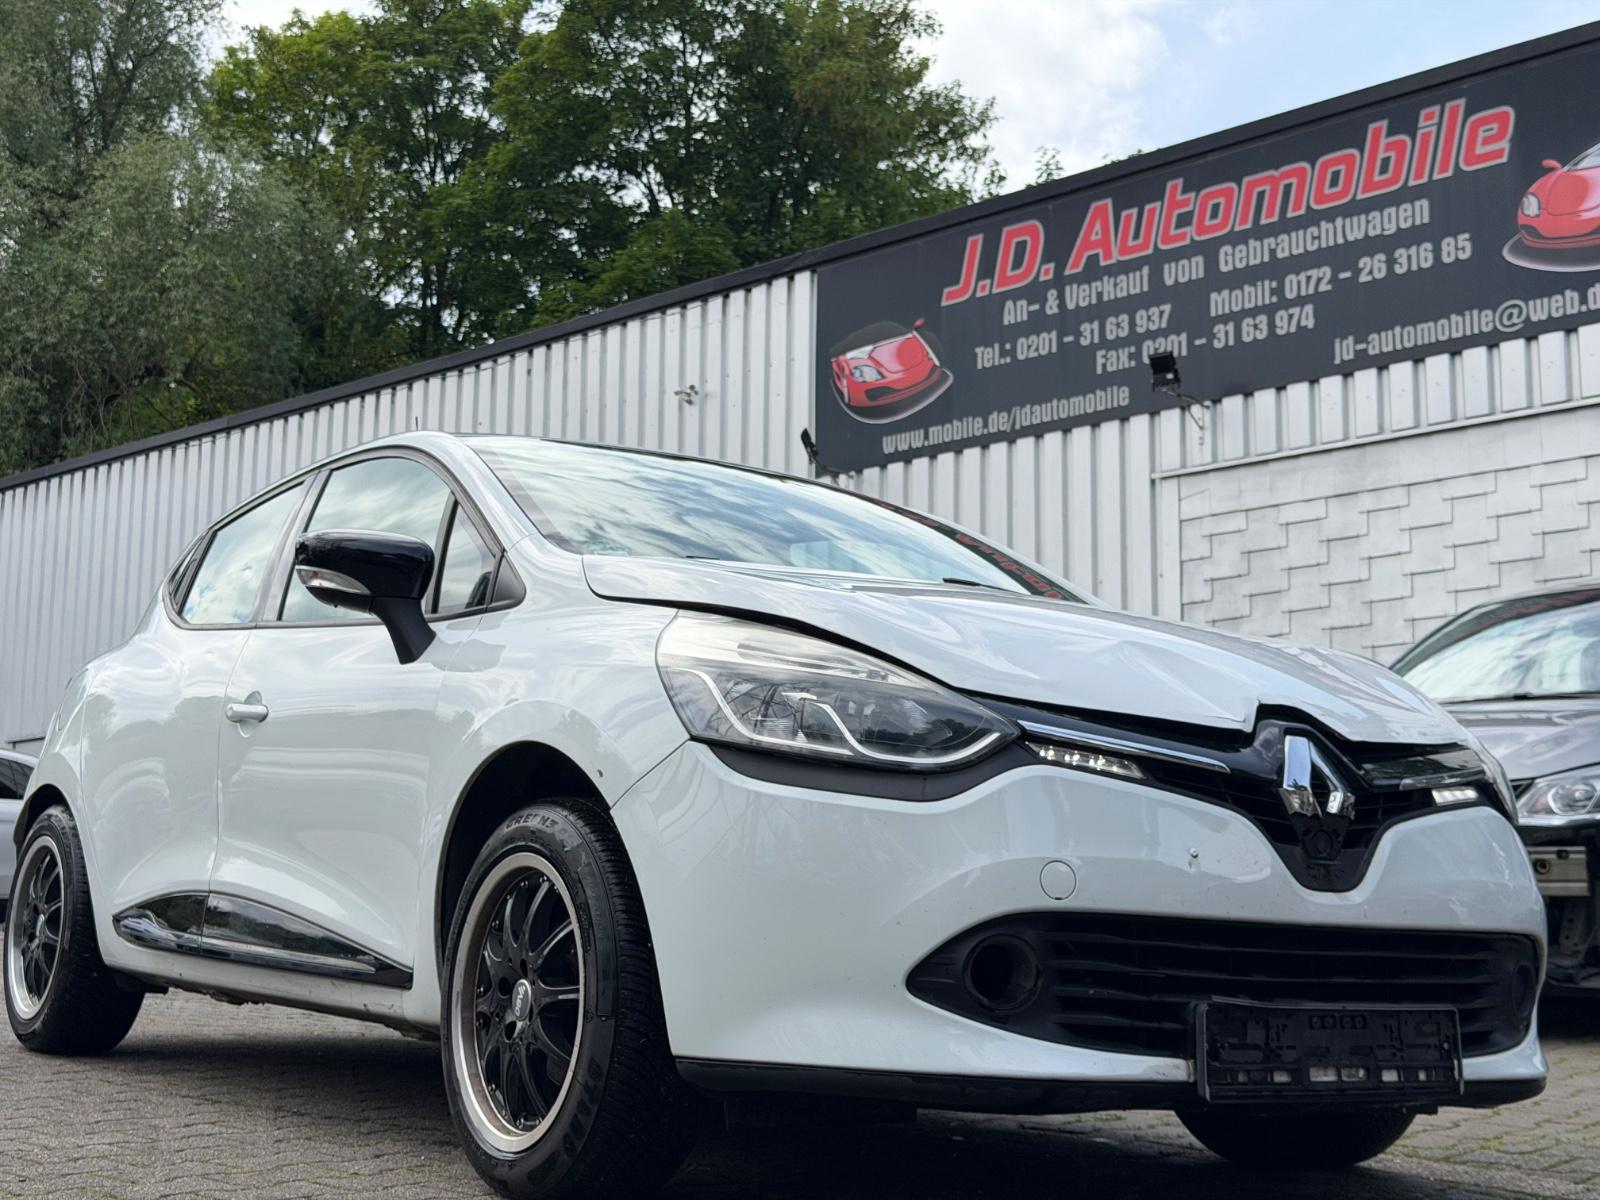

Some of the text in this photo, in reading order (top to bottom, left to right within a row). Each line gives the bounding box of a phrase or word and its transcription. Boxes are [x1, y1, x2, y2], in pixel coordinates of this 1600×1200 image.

[941, 98, 1515, 306] J.D. Automobile
[1003, 198, 1431, 326] An- & Verkauf von Gebrauchtwagen
[1209, 279, 1278, 317] Mobil:
[1284, 265, 1333, 300] 0172
[1358, 253, 1387, 283] 26
[1393, 246, 1434, 275] 316
[1441, 233, 1472, 263] 85
[974, 343, 1011, 370] Tel.:
[1016, 333, 1058, 361] 0201
[1079, 320, 1100, 346] 31
[1105, 315, 1129, 340] 63
[1135, 304, 1172, 333] 937
[1095, 345, 1136, 375] Fax:
[1212, 321, 1235, 349] 31
[1241, 316, 1269, 343] 63
[1275, 303, 1315, 336] 974
[882, 384, 1130, 454] www.mobile.de/jdautomobile
